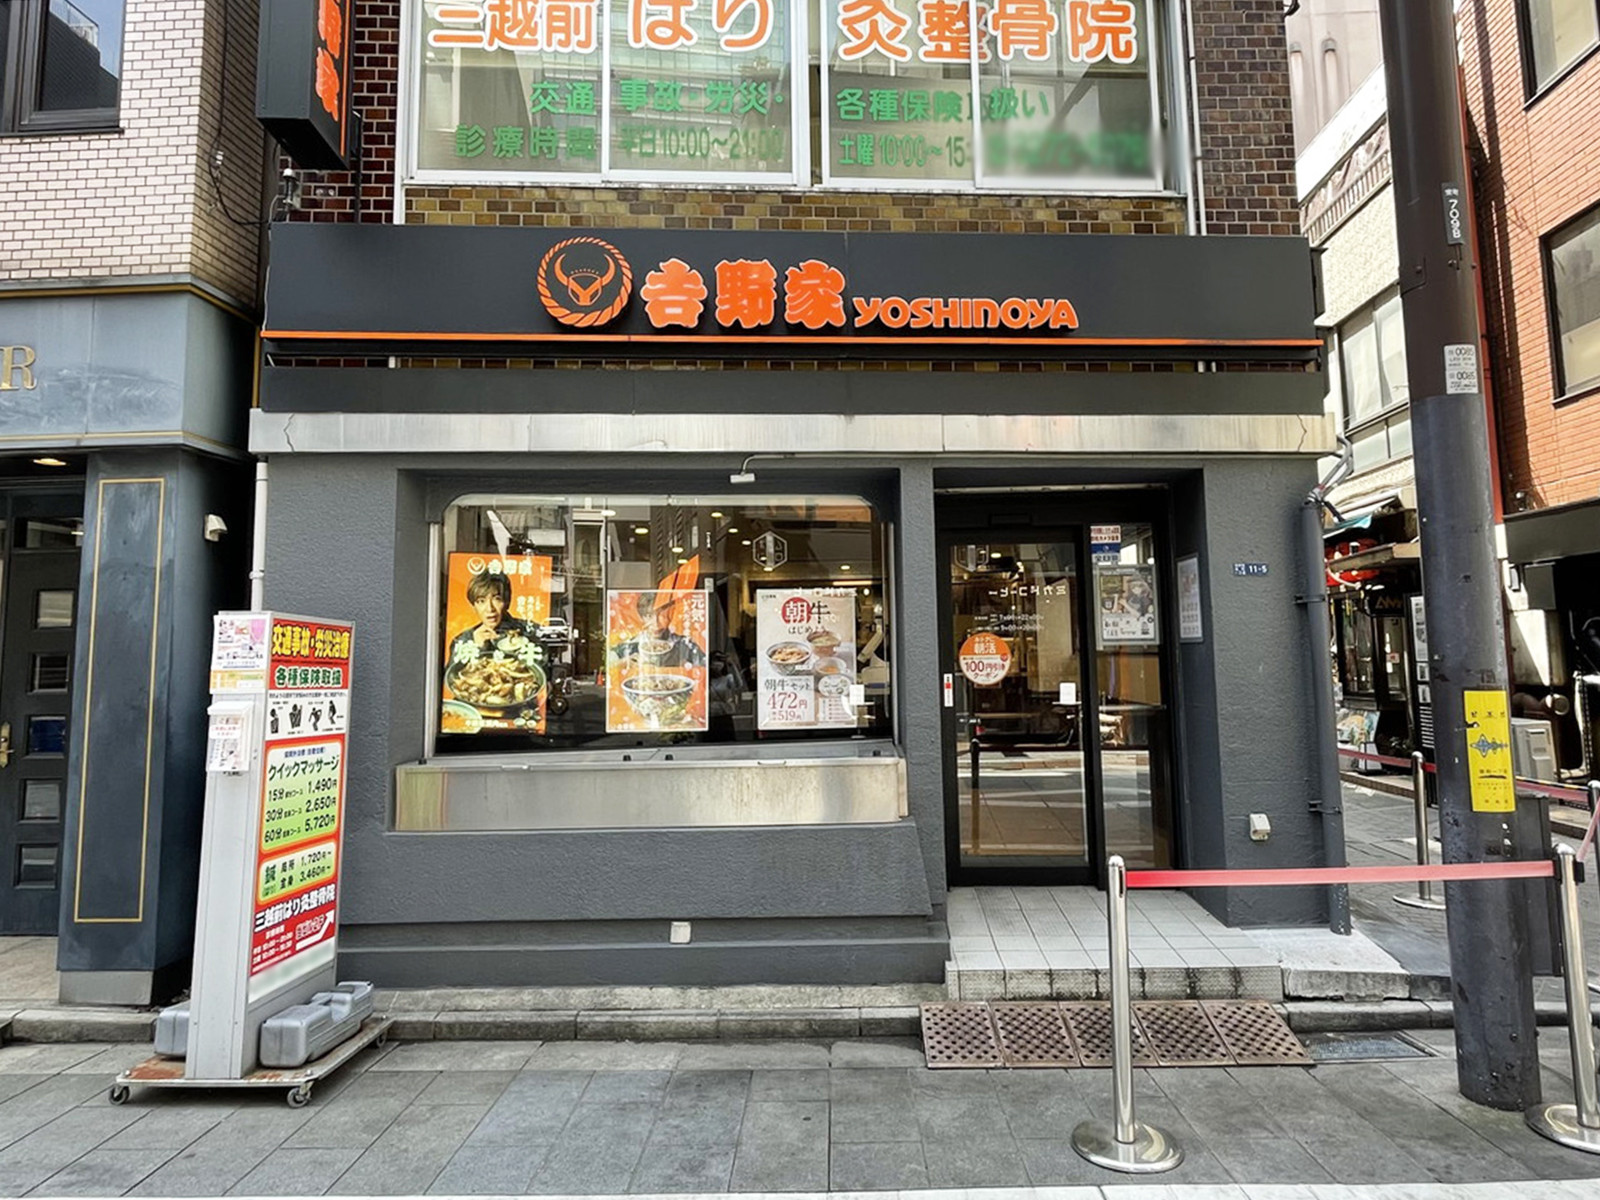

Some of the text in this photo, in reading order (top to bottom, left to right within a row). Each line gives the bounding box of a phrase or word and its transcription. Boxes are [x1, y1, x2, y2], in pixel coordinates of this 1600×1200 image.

[628, 0, 776, 51] はり
[531, 81, 596, 115] 交通
[640, 258, 846, 329] 吉野家
[853, 296, 1079, 330] YOSHINOYA
[1248, 565, 1268, 574] 11-5
[784, 600, 831, 624] 朝牛
[767, 692, 807, 709] 472円
[268, 755, 339, 781] クイックマッサージ
